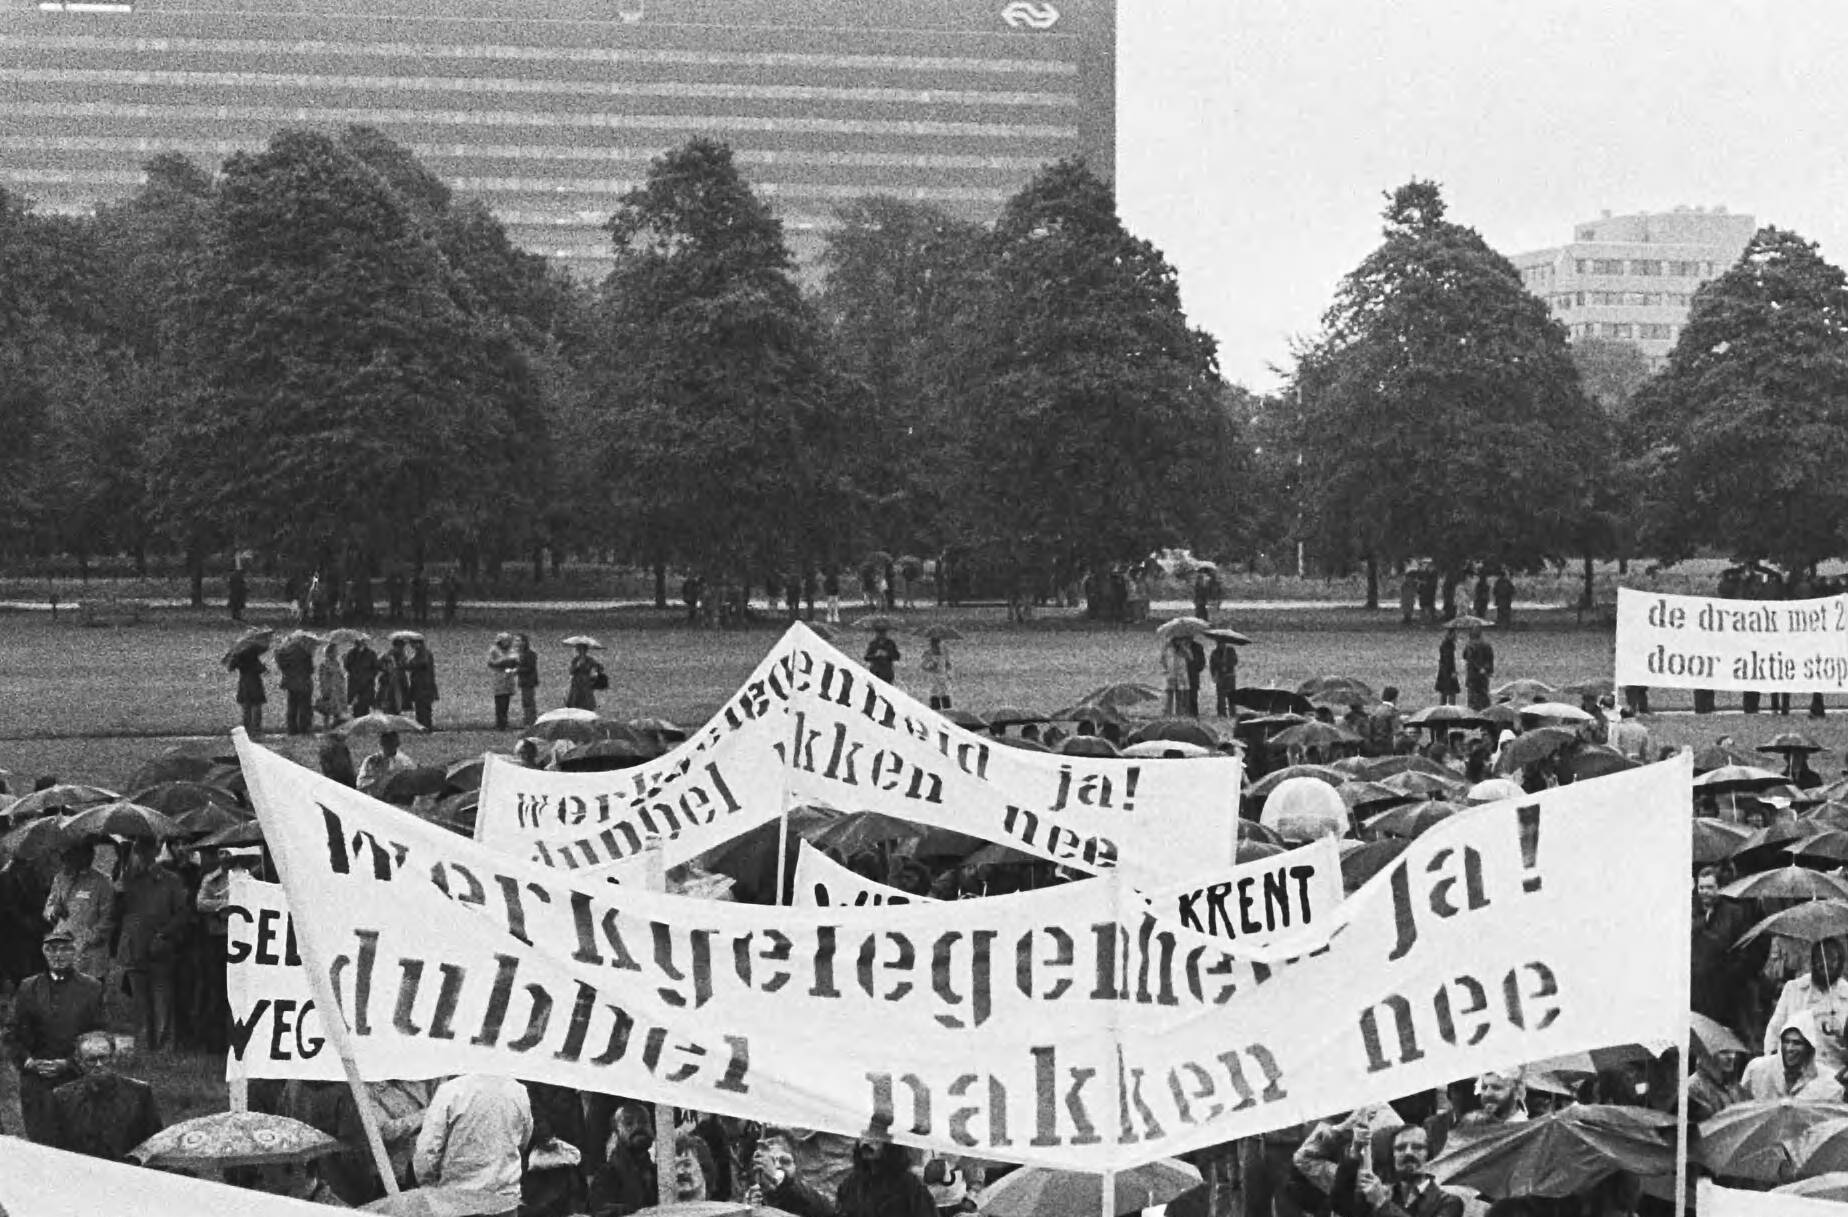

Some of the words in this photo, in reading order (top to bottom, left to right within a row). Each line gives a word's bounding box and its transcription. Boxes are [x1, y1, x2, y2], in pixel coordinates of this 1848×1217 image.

[1648, 599, 1686, 630] de
[1699, 601, 1778, 634] draak
[1788, 605, 1827, 632] met
[1835, 600, 1847, 631] 2
[1648, 645, 1721, 678] door
[1733, 650, 1796, 682] aktie
[1002, 804, 1118, 868] nee
[1178, 864, 1316, 940] KRENT
[325, 929, 749, 1094] dubbel
[860, 1042, 1287, 1146] pakken
[1358, 960, 1561, 1074] nee
